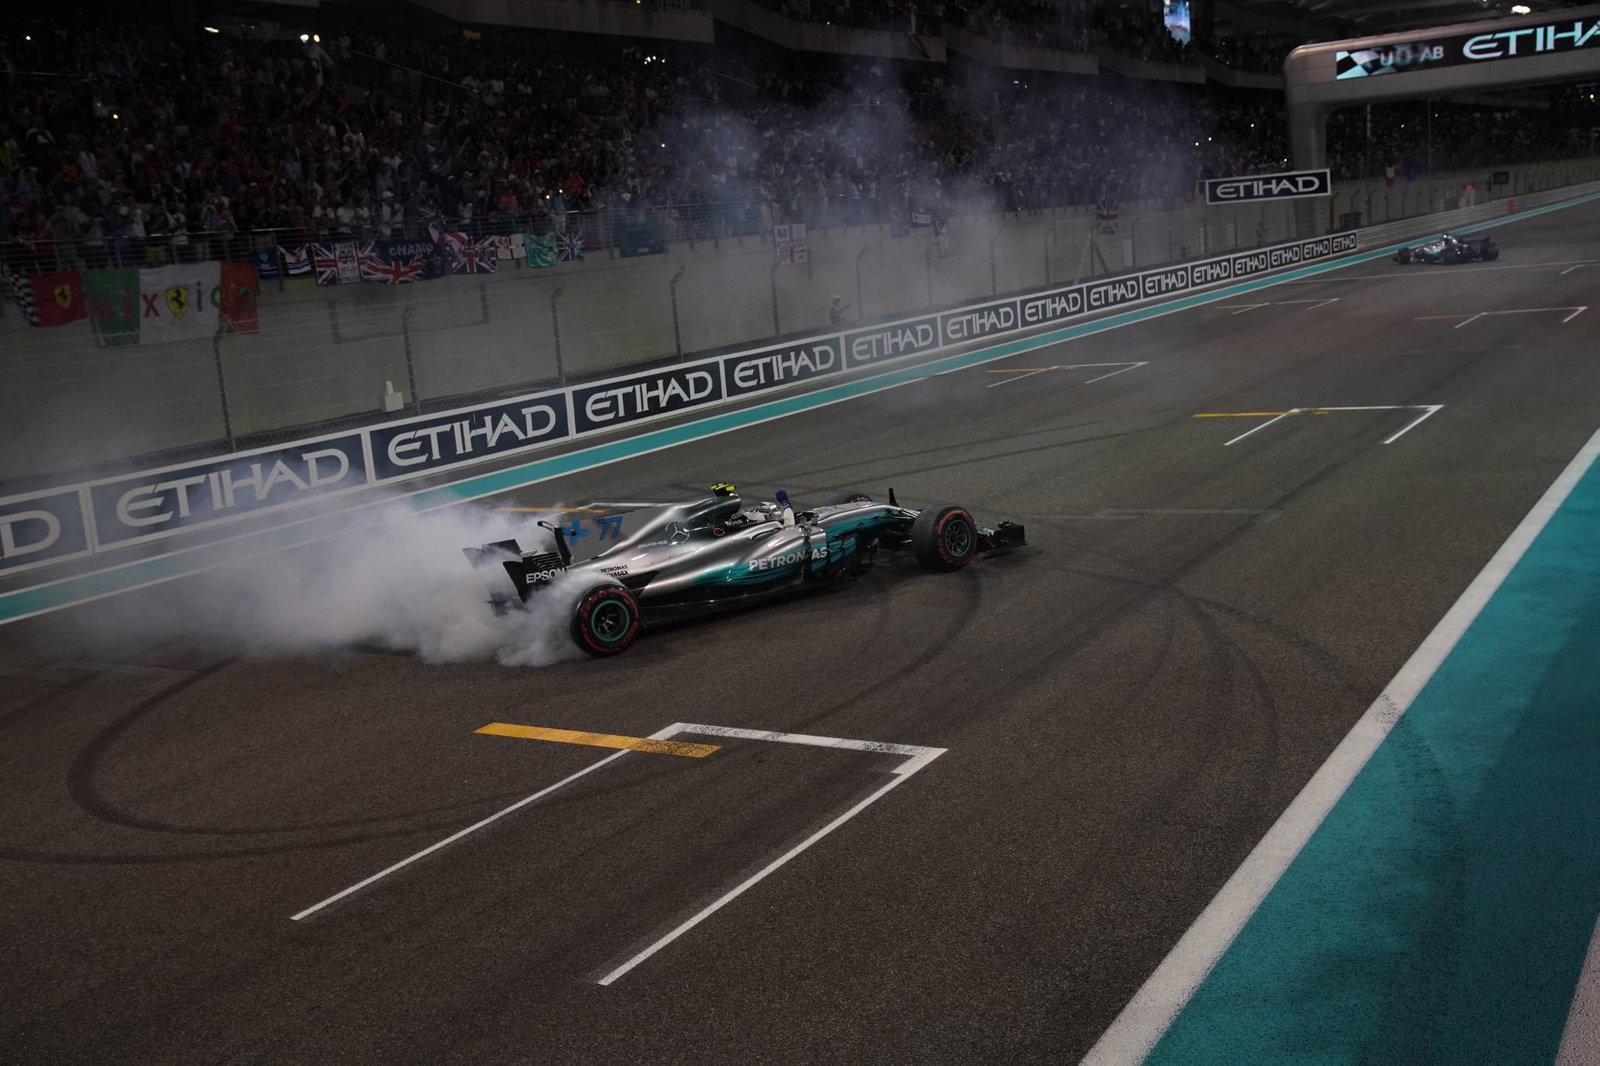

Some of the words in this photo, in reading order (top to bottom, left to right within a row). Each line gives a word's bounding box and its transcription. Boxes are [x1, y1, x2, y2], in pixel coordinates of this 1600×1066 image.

[1216, 172, 1320, 199] ETIHAD
[1271, 247, 1300, 266] ETIHAD
[1304, 240, 1330, 259] ETIHAD
[1193, 262, 1230, 284] ETIHAD
[1235, 254, 1267, 275] ETIHAD
[1090, 280, 1138, 307] ETIHAD
[1145, 270, 1187, 294] ETIHAD
[1025, 292, 1081, 322] ETIHAD
[947, 306, 1015, 339] ETIHAD
[852, 324, 934, 361] ETIHAD
[734, 345, 835, 388] ETIHAD
[586, 371, 714, 423] ETIHAD
[388, 404, 556, 467] ETIHAD
[116, 448, 350, 527] ETIHAD
[597, 516, 623, 541] 77
[748, 546, 829, 571] PETRONAS
[525, 566, 566, 584] EPSON
